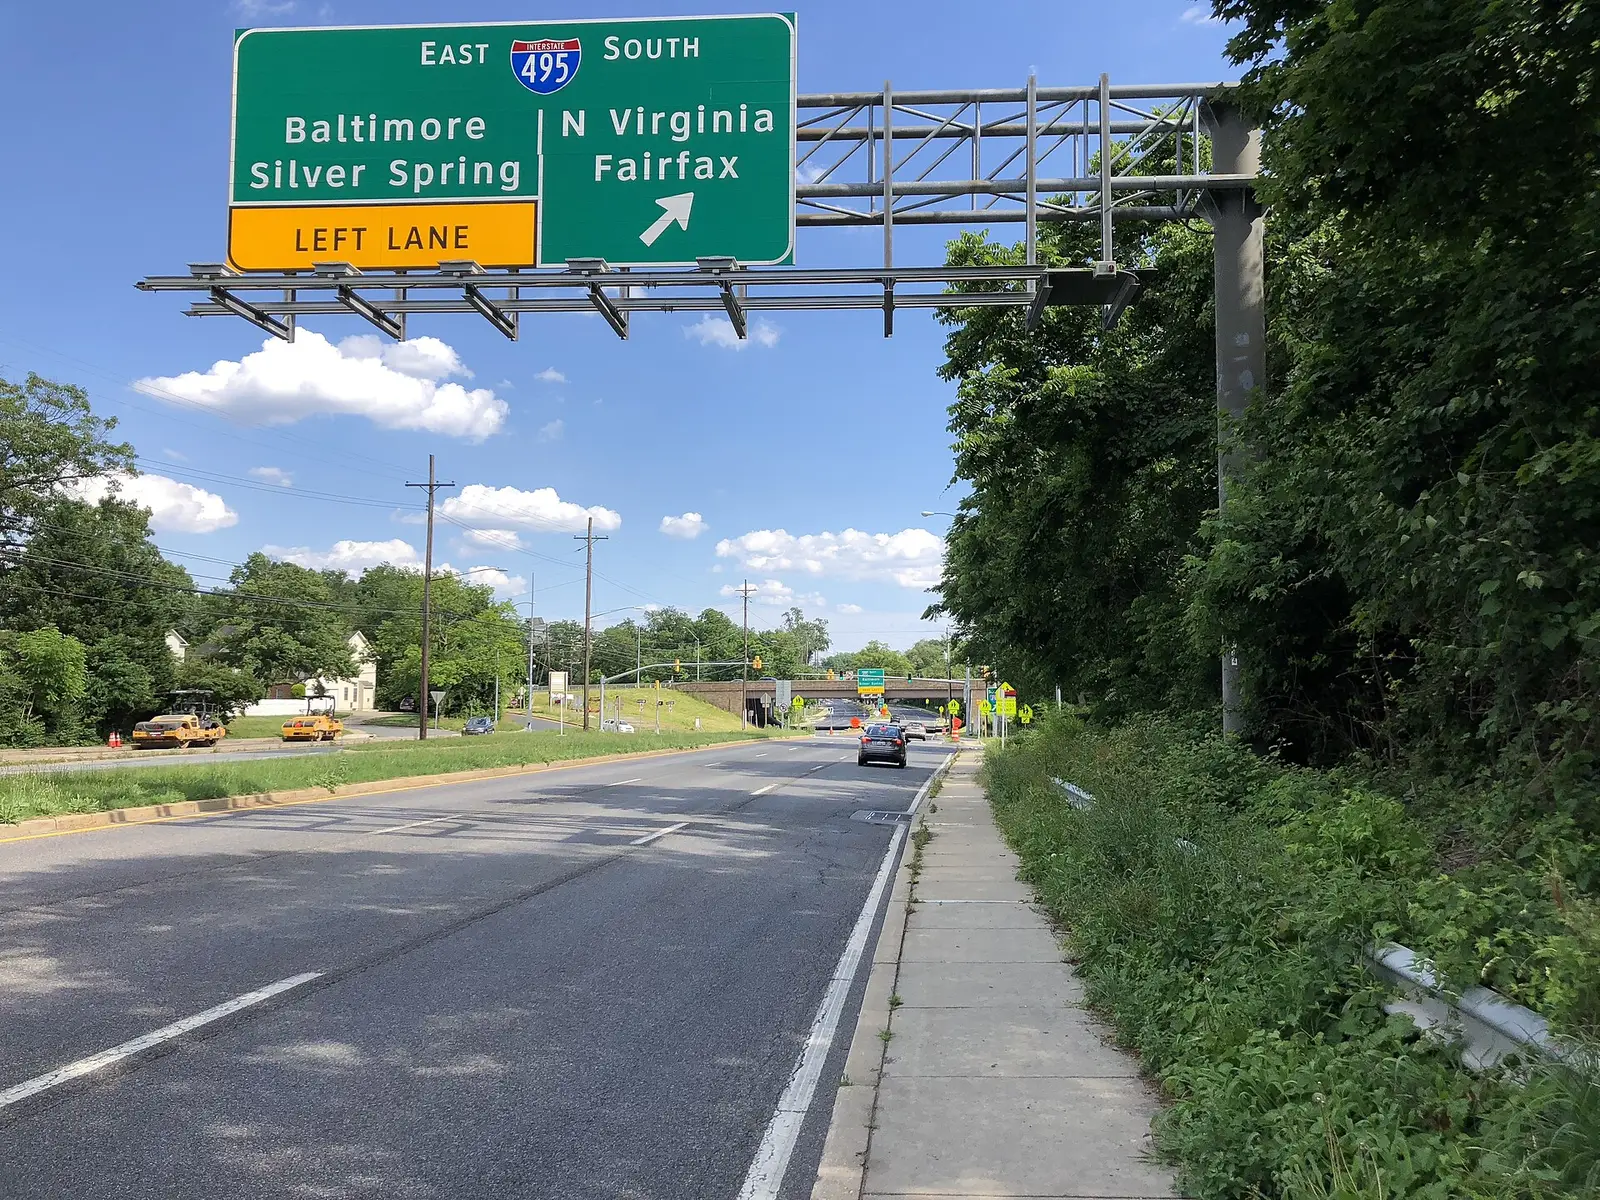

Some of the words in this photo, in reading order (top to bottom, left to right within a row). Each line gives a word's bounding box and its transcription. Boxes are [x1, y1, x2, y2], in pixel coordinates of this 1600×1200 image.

[421, 41, 489, 66] EAST
[526, 42, 565, 51] INTERSTATE
[603, 36, 699, 61] SOUTH
[521, 52, 569, 84] 495
[285, 113, 486, 144] Baltimore
[562, 109, 585, 137] N
[609, 104, 775, 142] Virginia
[250, 160, 366, 189] Silver
[389, 155, 520, 193] Spring
[595, 151, 739, 182] Fairfax
[295, 227, 367, 252] LEFT
[388, 225, 469, 250] LANE
